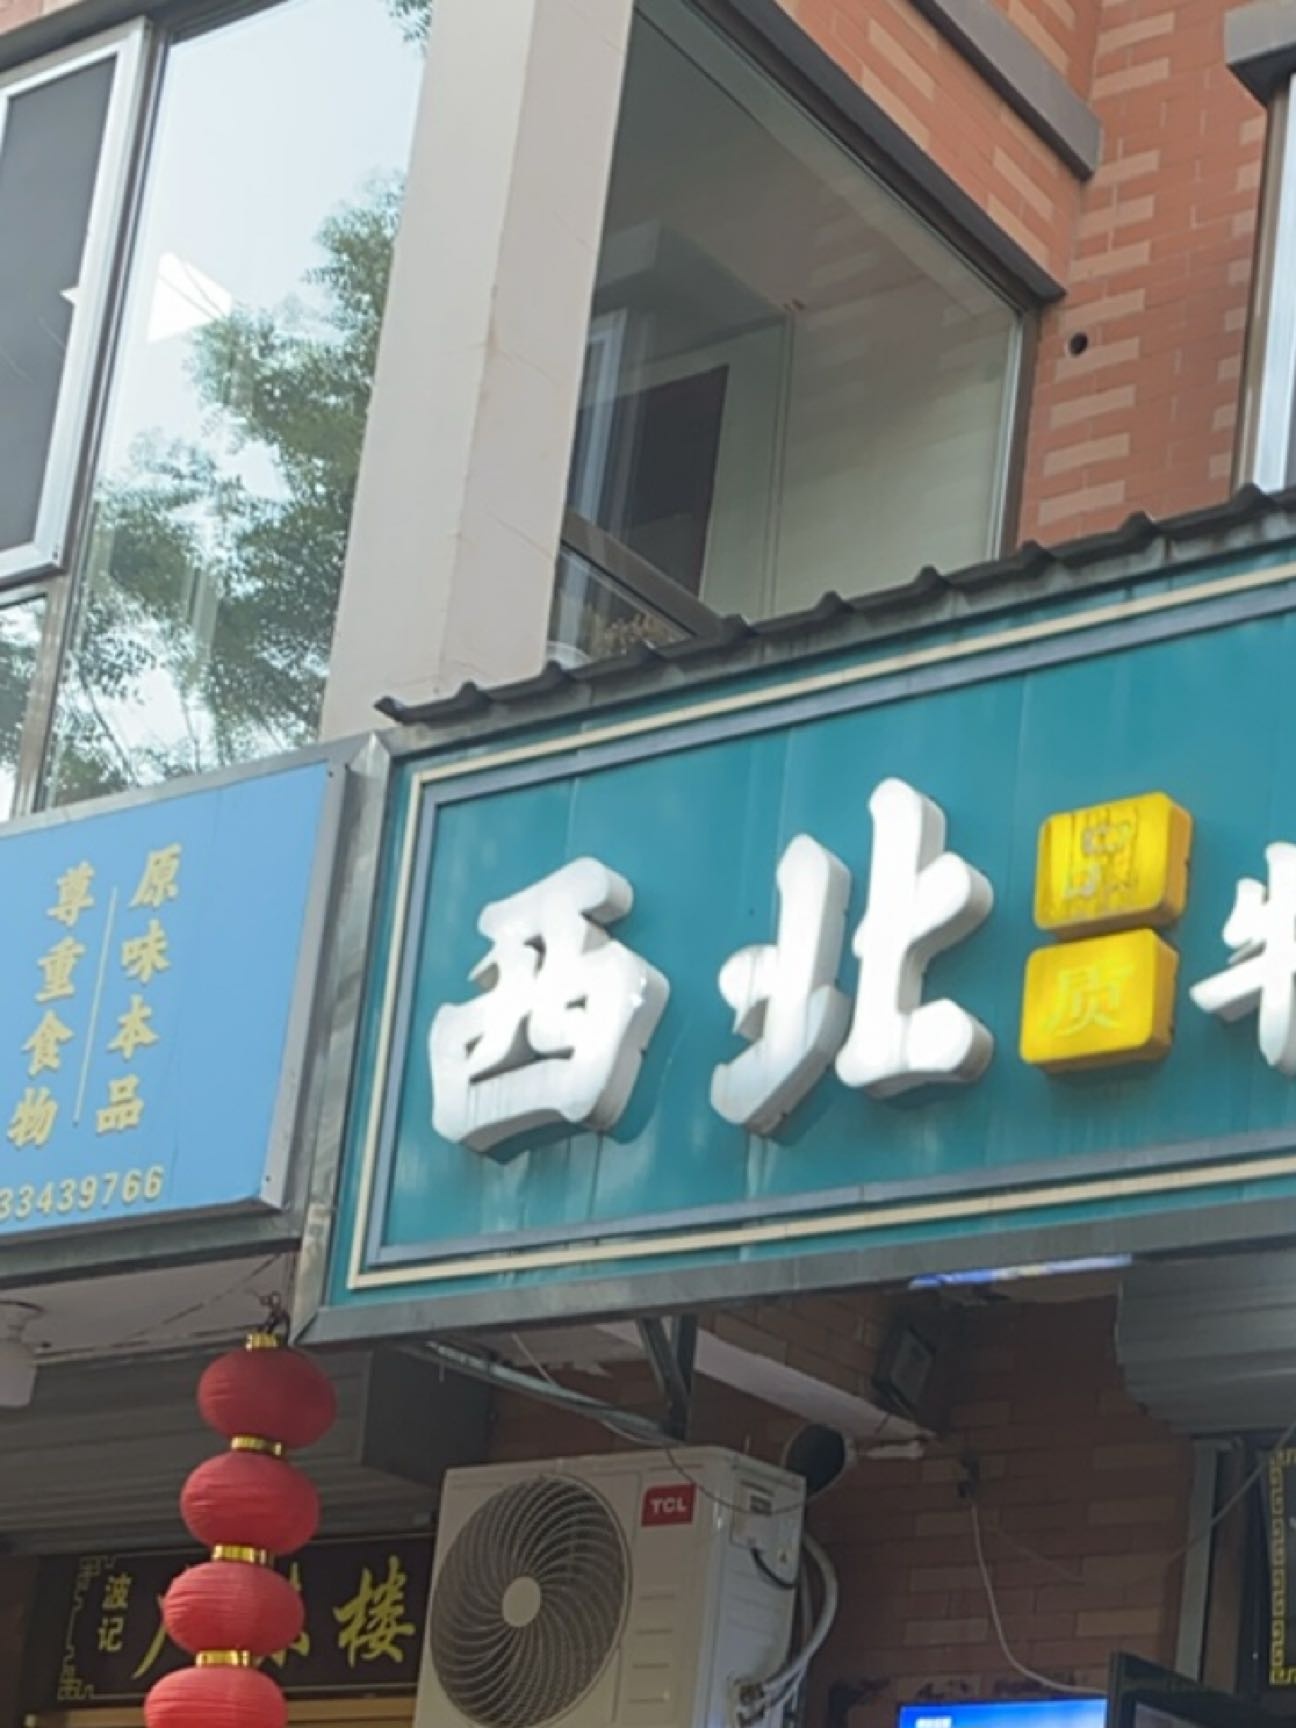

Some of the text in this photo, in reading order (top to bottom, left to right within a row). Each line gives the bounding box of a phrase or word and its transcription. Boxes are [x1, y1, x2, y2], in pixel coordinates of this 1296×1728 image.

[8, 862, 95, 1147] 尊重食物
[97, 844, 181, 1134] 原味本品
[429, 777, 993, 1163] 西北
[650, 1497, 687, 1513] TCL
